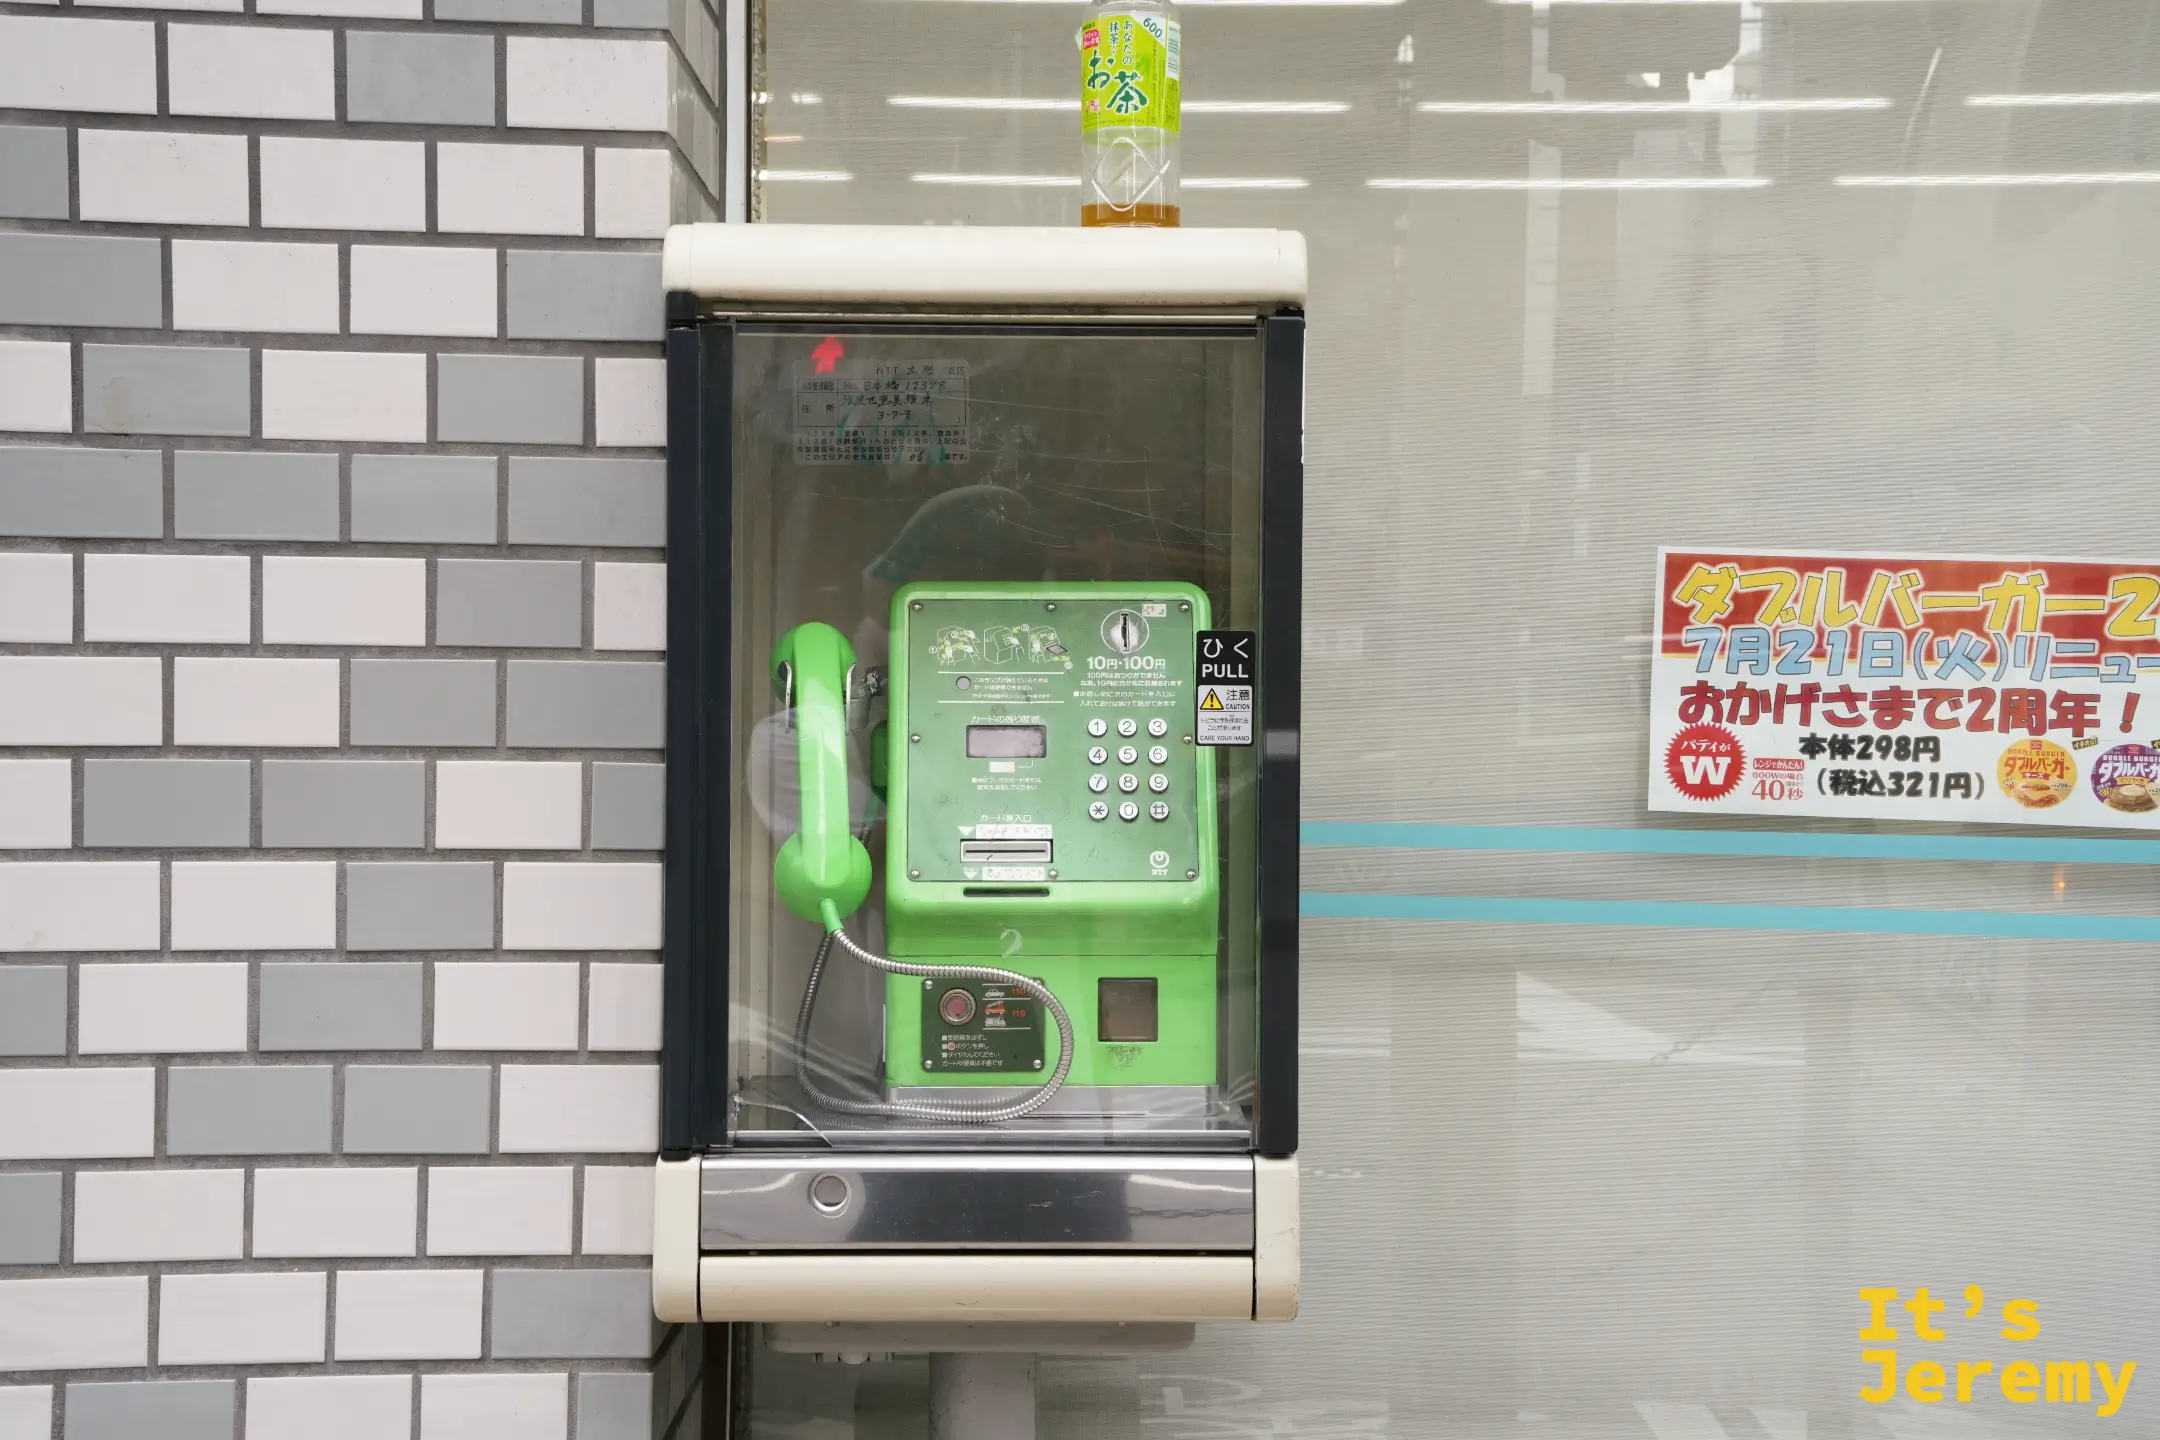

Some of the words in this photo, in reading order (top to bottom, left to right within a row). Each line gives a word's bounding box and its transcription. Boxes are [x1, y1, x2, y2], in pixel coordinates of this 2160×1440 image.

[1143, 17, 1163, 39] 600
[1122, 20, 1133, 65] あなたの
[1088, 50, 1148, 114] お茶
[876, 366, 898, 375] NTT
[844, 381, 860, 390] No.
[1676, 566, 2160, 637] ダブルバーガー2
[1203, 638, 1249, 659] ひく
[1202, 664, 1249, 678] PULL
[1225, 689, 1250, 701] 注意
[1094, 722, 1101, 733] 1
[1123, 722, 1132, 733] 2
[1153, 721, 1162, 733] 3
[1681, 739, 1731, 752] パティが
[1799, 733, 1941, 763] 本体298円
[1093, 750, 1102, 761] 4
[1123, 750, 1132, 761] 5
[1153, 749, 1163, 761] 6
[2133, 755, 2160, 763] BURGE
[1680, 756, 1731, 785] W
[1755, 760, 1804, 770] レンジでかんたん!
[2004, 757, 2070, 779] ダブルバーガー
[1752, 771, 1803, 780] 600Wの場合
[1094, 777, 1103, 788] 7
[1124, 777, 1133, 788] 8
[1154, 777, 1164, 788] 9
[1817, 767, 1985, 800] (税込321円)
[1124, 805, 1134, 816] 0
[1012, 1010, 1026, 1018] 119
